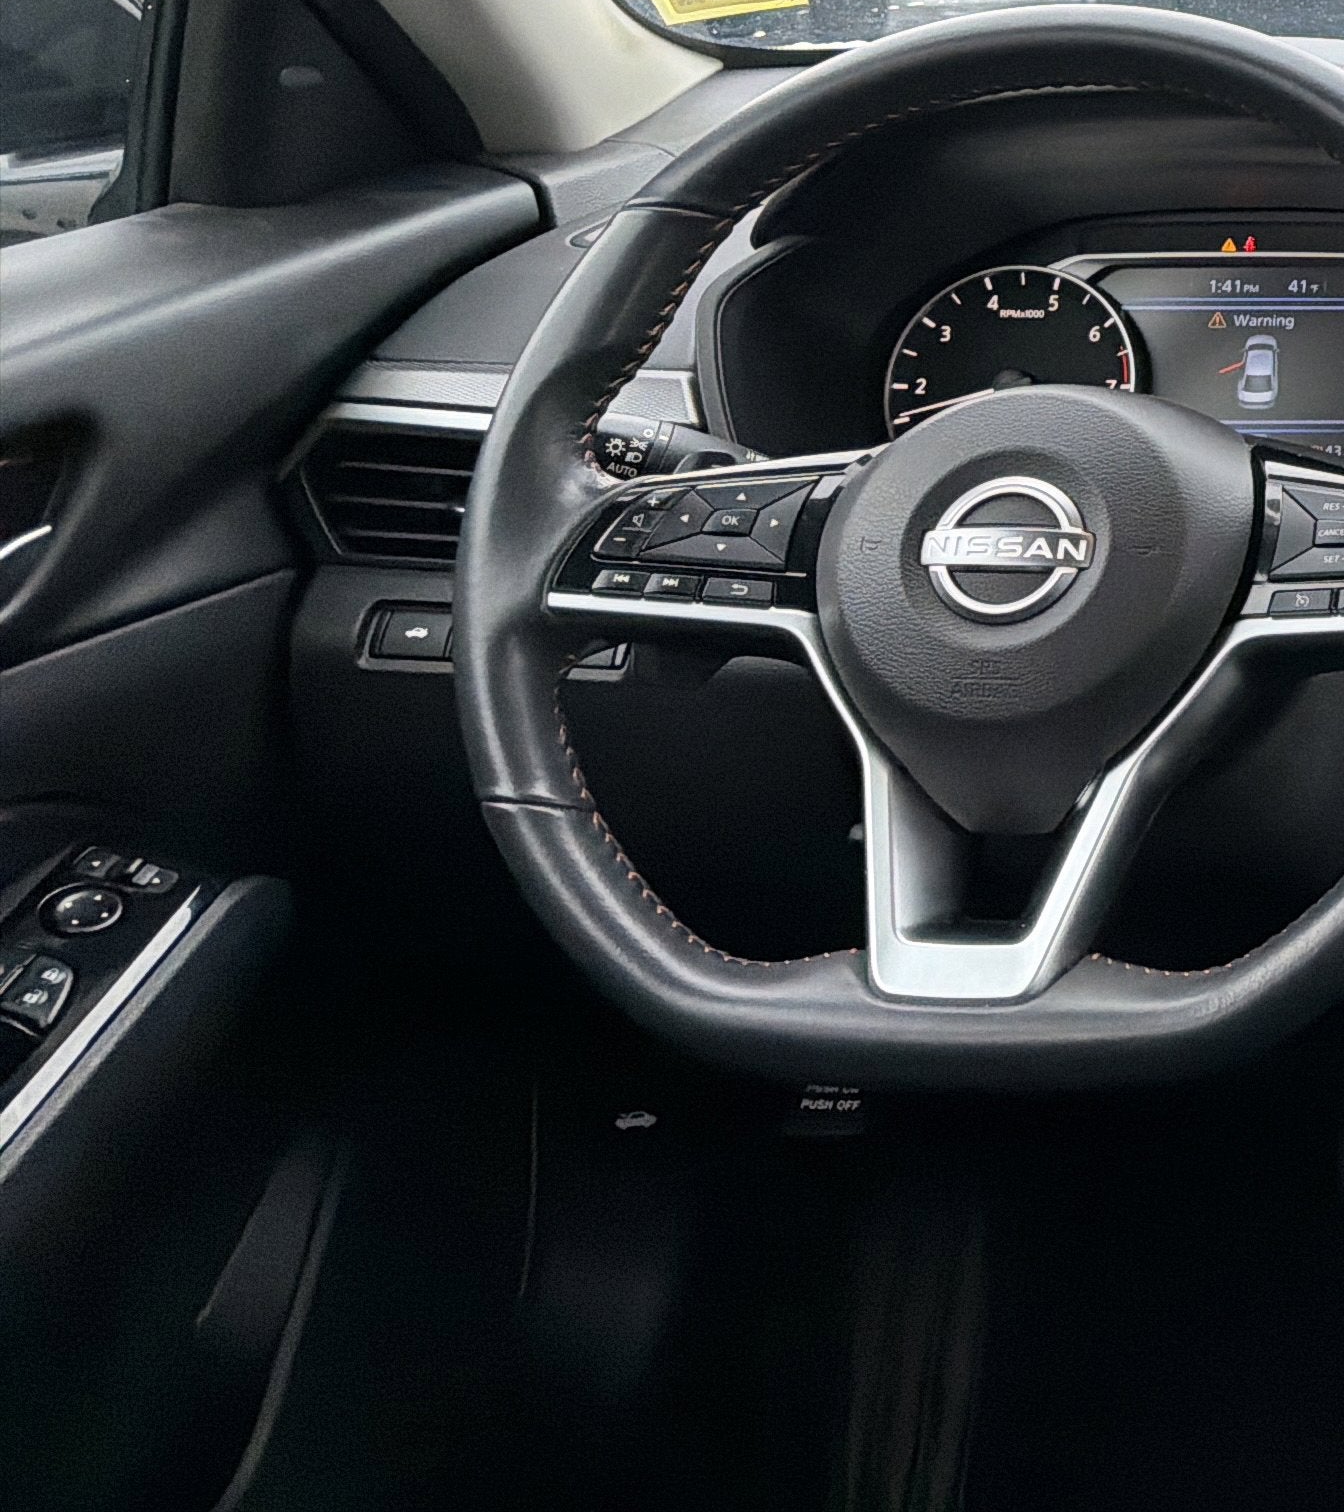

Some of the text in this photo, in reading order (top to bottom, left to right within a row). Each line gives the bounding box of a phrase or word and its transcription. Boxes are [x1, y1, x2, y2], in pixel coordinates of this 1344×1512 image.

[1209, 279, 1242, 293] 1:41
[1288, 279, 1307, 293] 41
[986, 294, 999, 310] 4
[1048, 294, 1059, 311] 5
[1233, 314, 1295, 330] Warning
[939, 325, 951, 342] 3
[1088, 326, 1101, 342] 6
[914, 377, 928, 395] 2
[606, 462, 638, 477] AUTO
[1322, 502, 1340, 511] RES
[721, 515, 741, 526] OK
[926, 535, 1089, 561] NISSAN
[1323, 555, 1339, 564] SET
[800, 1098, 861, 1111] PUSH OFF
